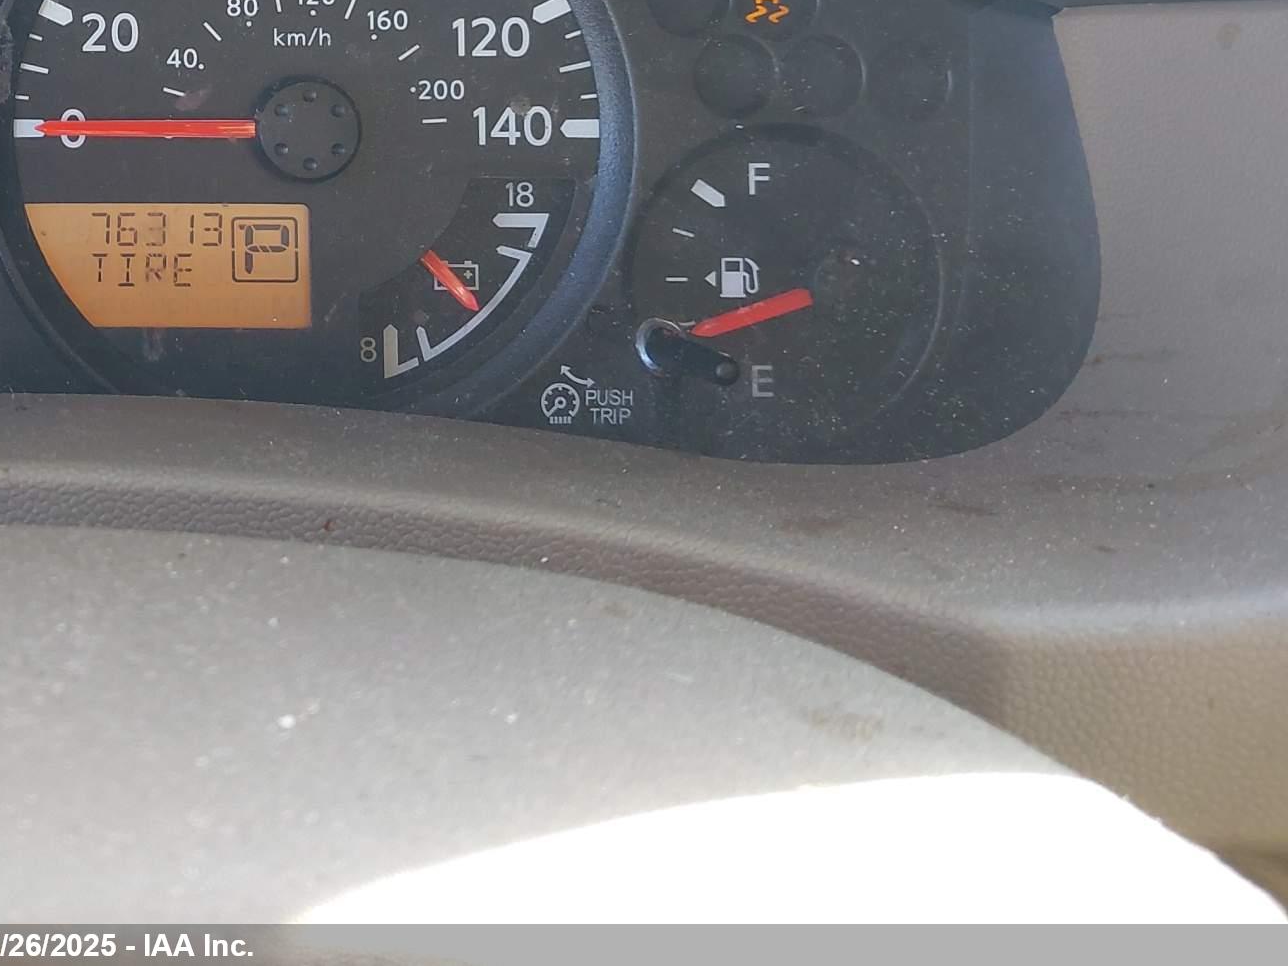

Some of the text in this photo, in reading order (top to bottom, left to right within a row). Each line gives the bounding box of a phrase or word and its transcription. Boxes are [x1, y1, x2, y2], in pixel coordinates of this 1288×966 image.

[81, 12, 139, 53] 20
[272, 26, 332, 48] km/h
[366, 9, 408, 32] 160
[452, 17, 530, 58] 120
[417, 79, 465, 101] 200
[472, 106, 553, 147] 140
[505, 182, 535, 208] 18
[747, 162, 771, 196] F
[90, 212, 224, 248] 76313
[239, 224, 289, 275] P
[91, 252, 194, 288] TIRE
[359, 337, 377, 363] 8
[751, 365, 773, 398] E
[585, 388, 634, 409] PUSH
[589, 408, 631, 425] TRIP
